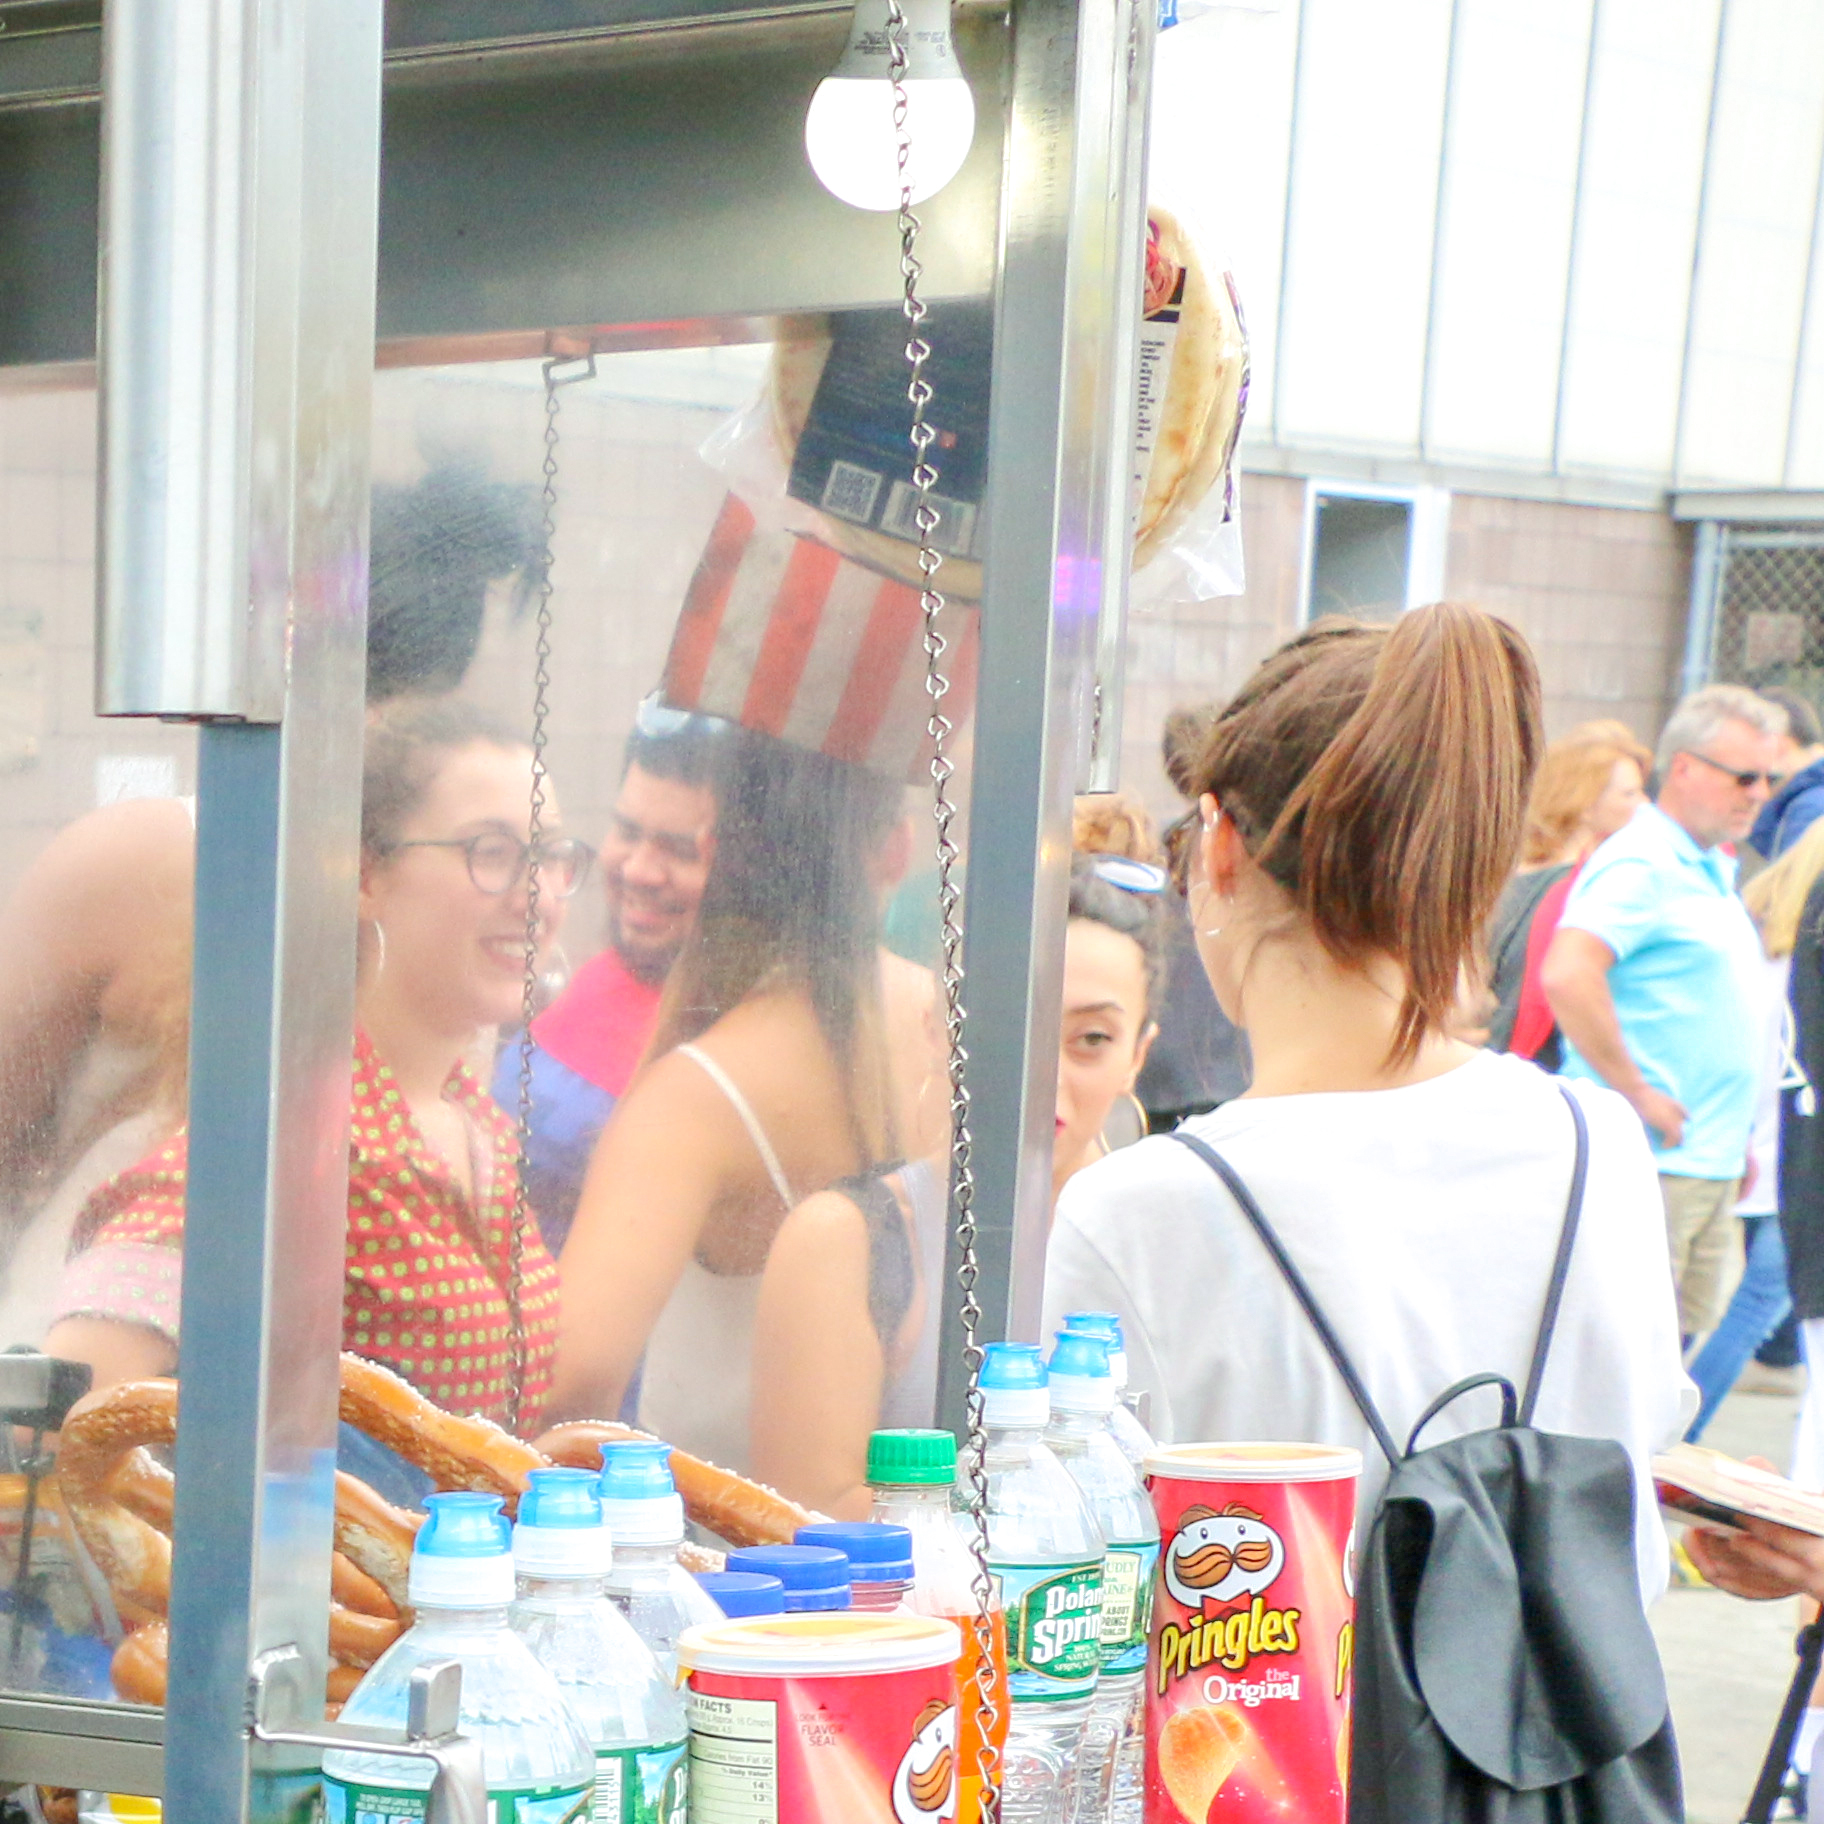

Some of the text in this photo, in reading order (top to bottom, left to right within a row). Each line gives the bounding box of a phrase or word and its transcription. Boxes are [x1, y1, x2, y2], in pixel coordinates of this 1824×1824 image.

[1045, 1584, 1102, 1618] Polan
[1031, 1608, 1101, 1665] Sprin
[1158, 1595, 1301, 1696] Pringles
[1203, 1674, 1300, 1707] Original
[1265, 1668, 1290, 1681] the
[700, 1699, 732, 1714] FACTS
[808, 1735, 836, 1747] SEAL
